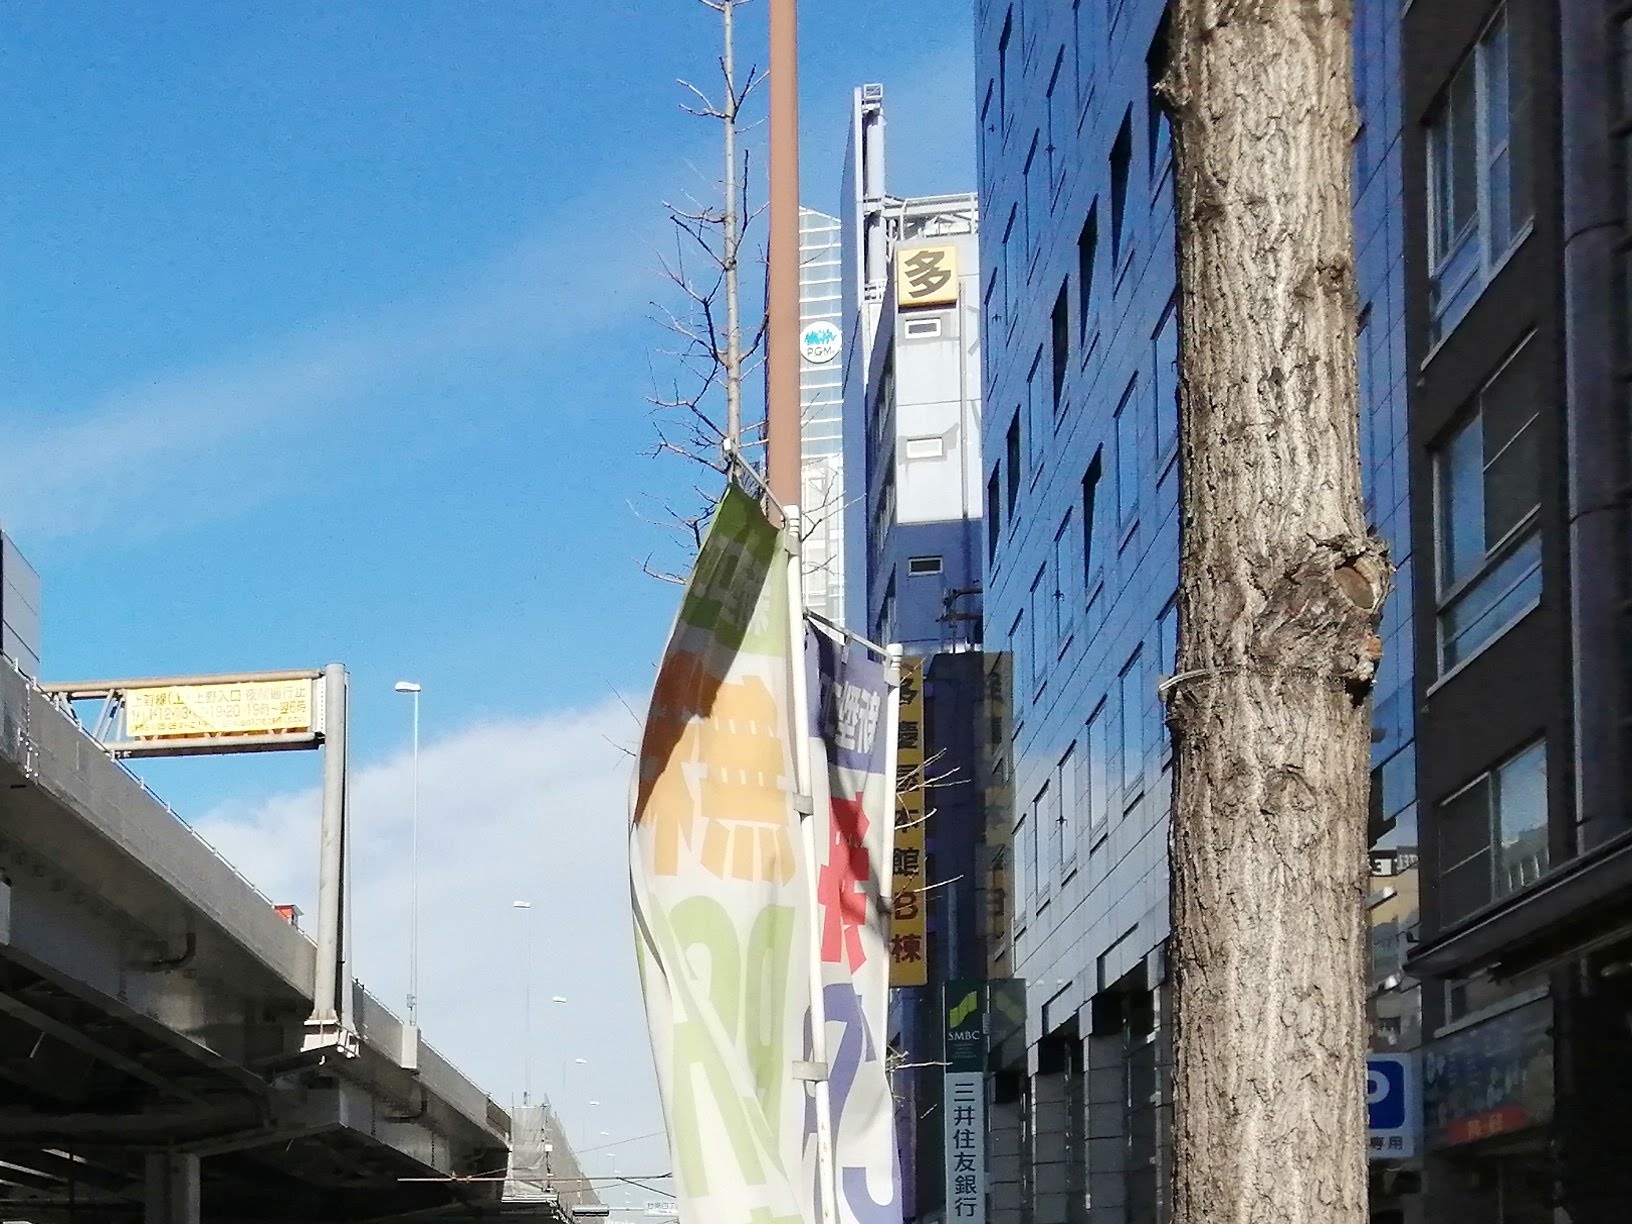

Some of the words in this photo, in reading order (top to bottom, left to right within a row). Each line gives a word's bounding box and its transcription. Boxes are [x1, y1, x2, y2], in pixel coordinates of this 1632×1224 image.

[905, 250, 951, 299] 多
[807, 346, 831, 357] PGM
[948, 1030, 980, 1041] SMBC
[953, 1082, 978, 1217] 三井住友銀行
